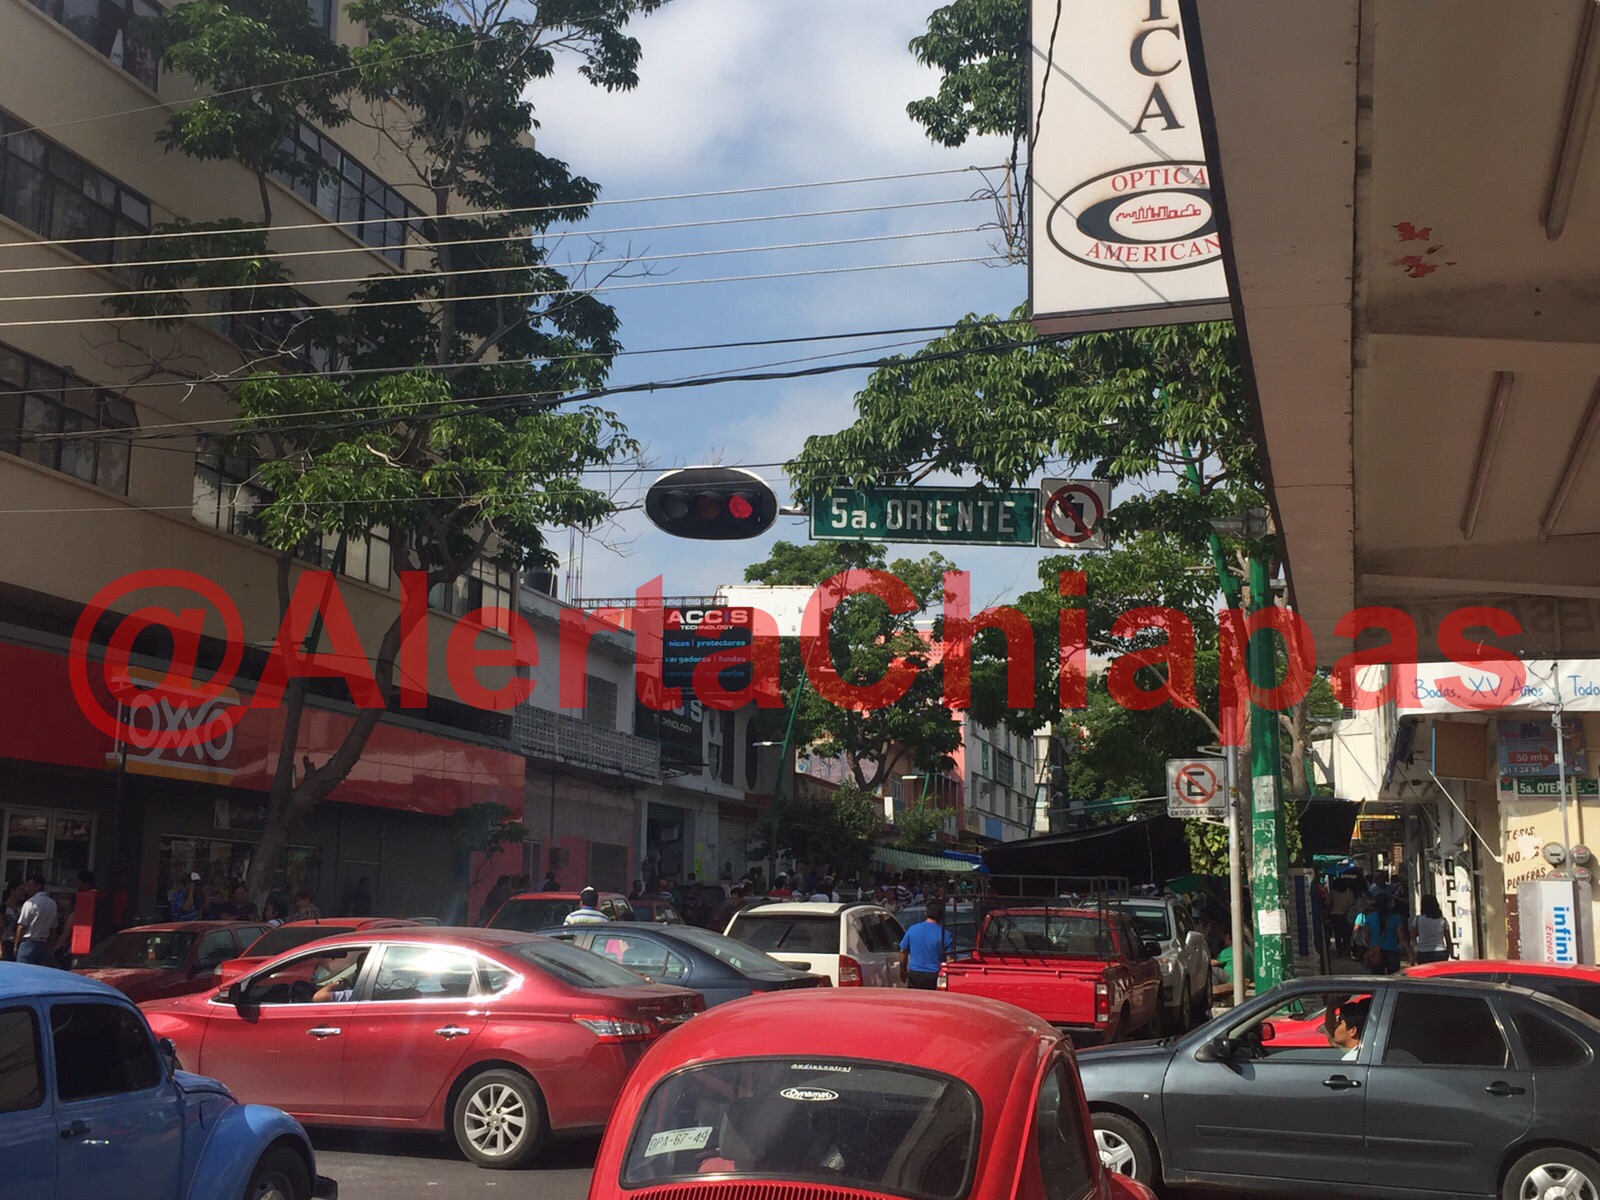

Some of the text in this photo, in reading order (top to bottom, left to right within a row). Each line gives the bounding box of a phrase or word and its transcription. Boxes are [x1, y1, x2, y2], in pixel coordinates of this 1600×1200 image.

[1111, 167, 1207, 192] OPTICA
[831, 497, 1015, 533] 5a. ORIENTE
[666, 609, 748, 624] ACCIS
[1469, 676, 1501, 698] XV
[128, 694, 234, 761] OXXO
[1520, 783, 1535, 793] 5a.
[1505, 826, 1535, 841] TESIS
[1553, 906, 1573, 962] infini
